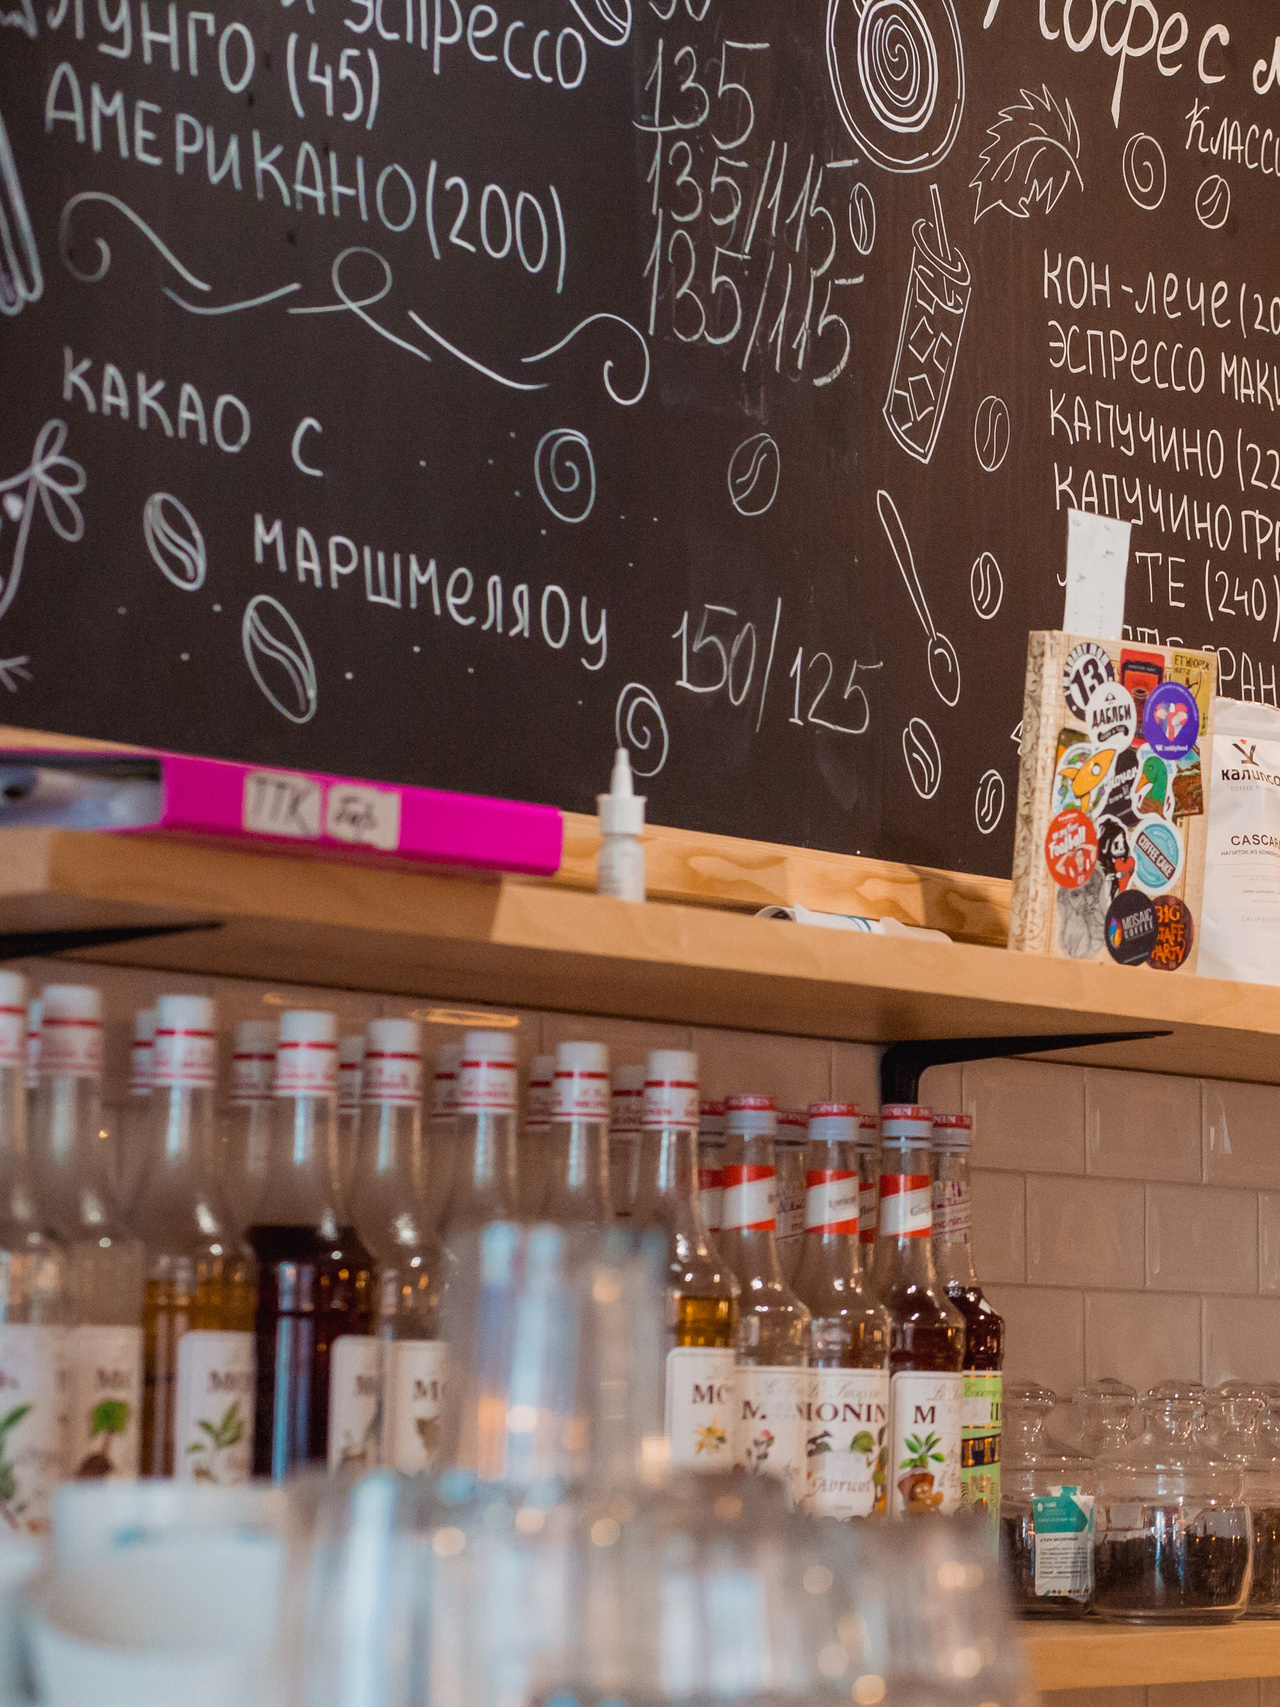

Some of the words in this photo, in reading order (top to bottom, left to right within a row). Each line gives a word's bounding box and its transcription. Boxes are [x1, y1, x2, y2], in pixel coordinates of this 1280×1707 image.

[286, 32, 380, 130] (45)
[62, 346, 251, 452] КАКАО
[1049, 389, 1225, 479] КАПУЧИНО
[1053, 462, 1233, 551] КАПУЧИНО
[671, 597, 883, 732] 150/125
[1091, 703, 1133, 729] ДАБЛБИ
